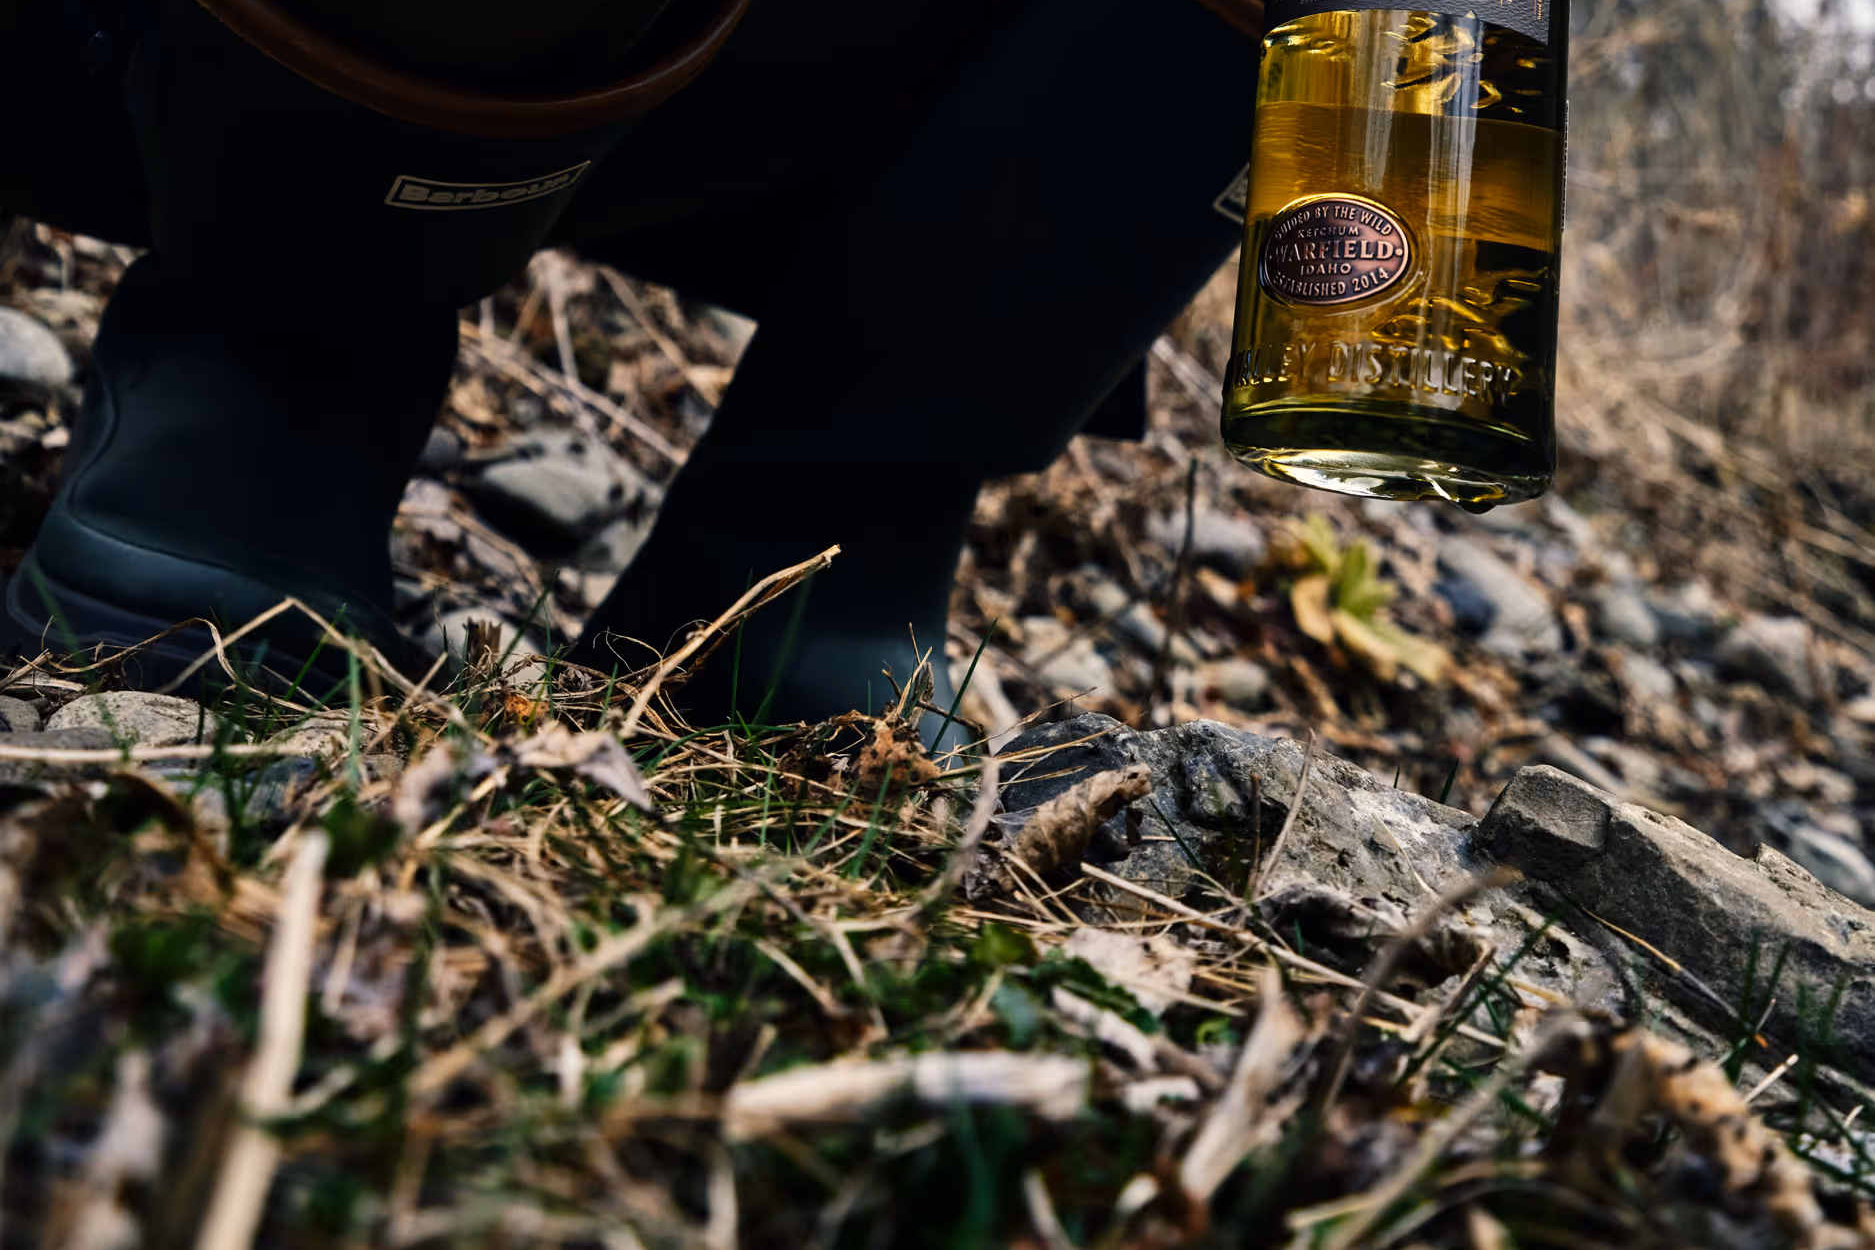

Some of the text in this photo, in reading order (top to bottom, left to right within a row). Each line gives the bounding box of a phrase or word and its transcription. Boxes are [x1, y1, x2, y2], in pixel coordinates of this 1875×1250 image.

[1275, 206, 1393, 239] GUIDED BY THE WILD
[1298, 226, 1359, 239] KETCHUM
[1276, 239, 1395, 263] WARFIELD
[1274, 266, 1391, 297] ESTABLISHED 2014
[1300, 262, 1352, 276] IDAHO
[1327, 340, 1512, 402] DISTILLERY
